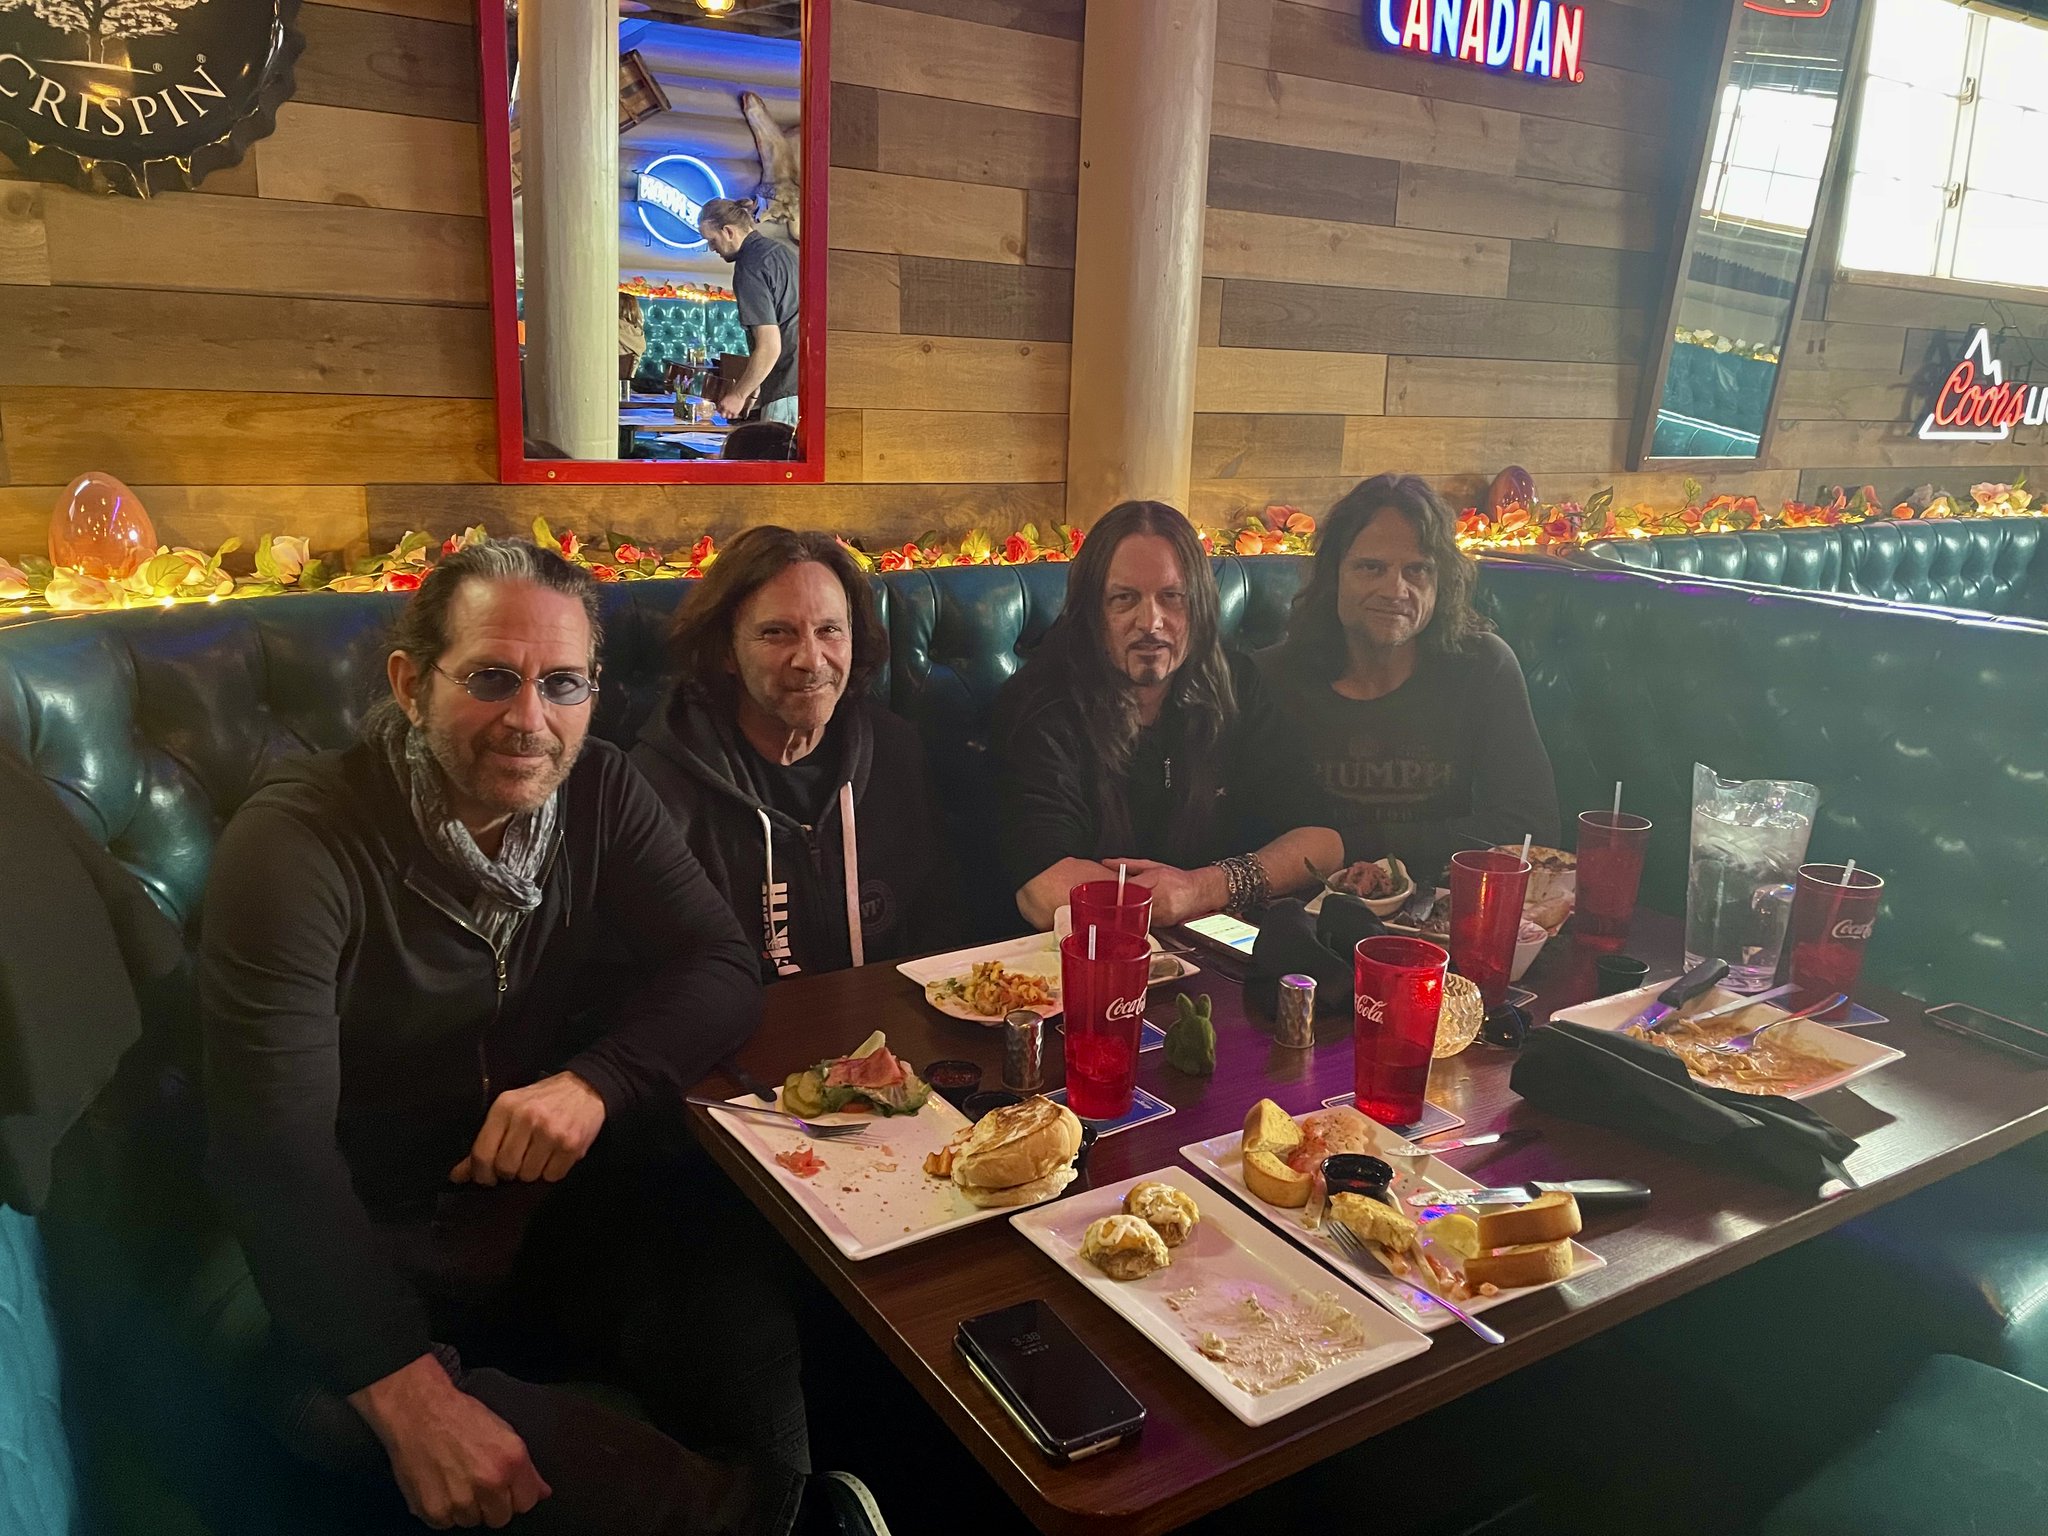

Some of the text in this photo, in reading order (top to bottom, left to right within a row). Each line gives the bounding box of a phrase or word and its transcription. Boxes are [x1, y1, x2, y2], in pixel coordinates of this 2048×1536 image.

[1379, 0, 1582, 82] CANADIAN
[0, 53, 226, 136] CRISPIN
[1935, 360, 2048, 427] Coors LI
[1354, 993, 1388, 1024] Cola
